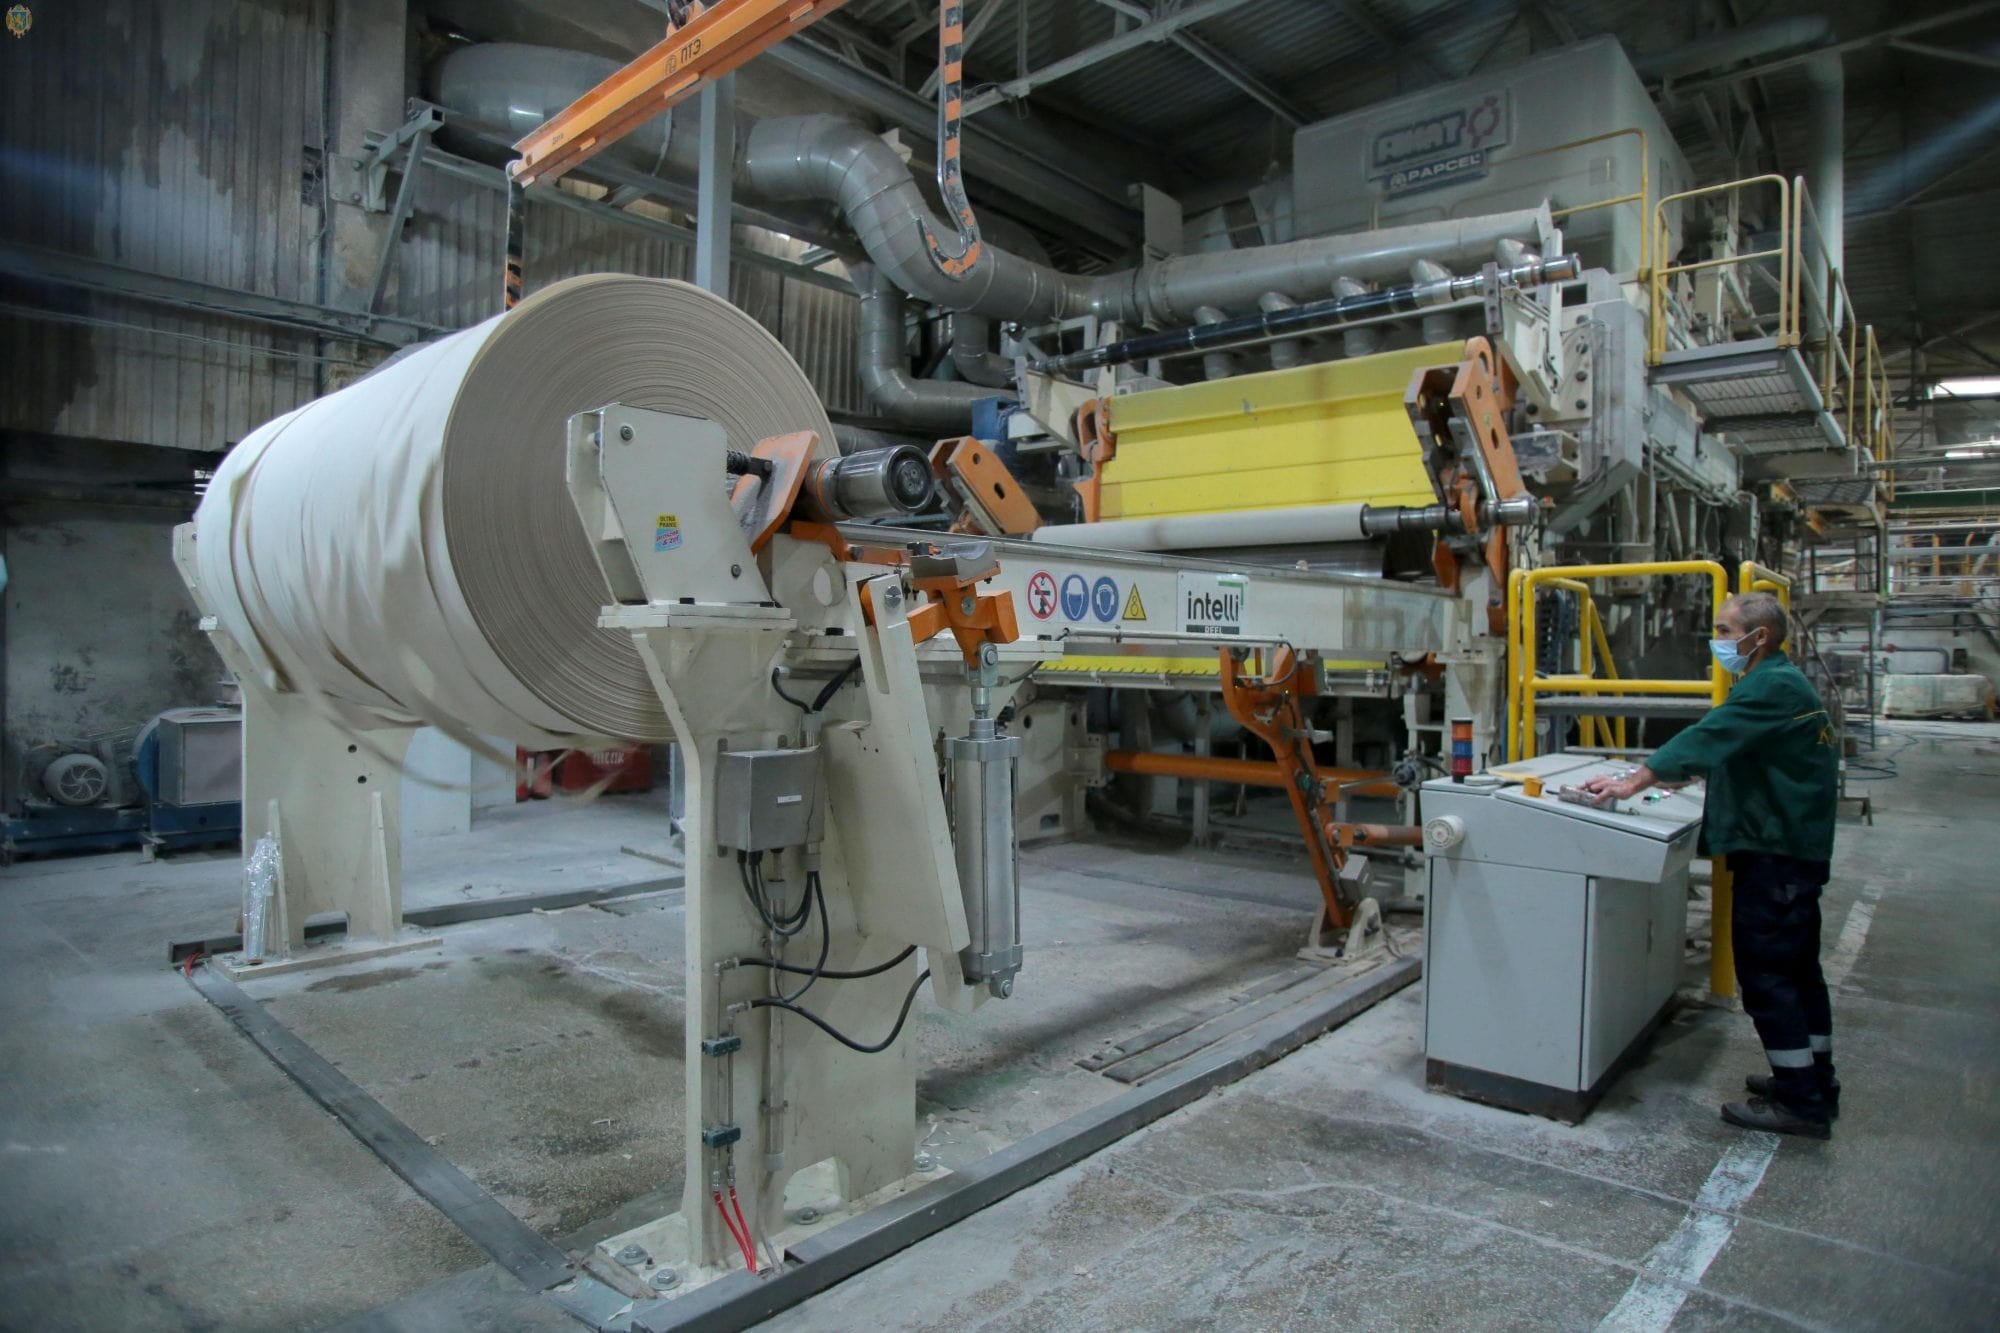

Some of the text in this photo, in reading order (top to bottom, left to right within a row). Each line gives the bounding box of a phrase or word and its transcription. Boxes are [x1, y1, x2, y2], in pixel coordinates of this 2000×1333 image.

[681, 37, 701, 59] ПТЭ
[1408, 154, 1481, 182] PAPCEL
[1187, 590, 1239, 622] intelli
